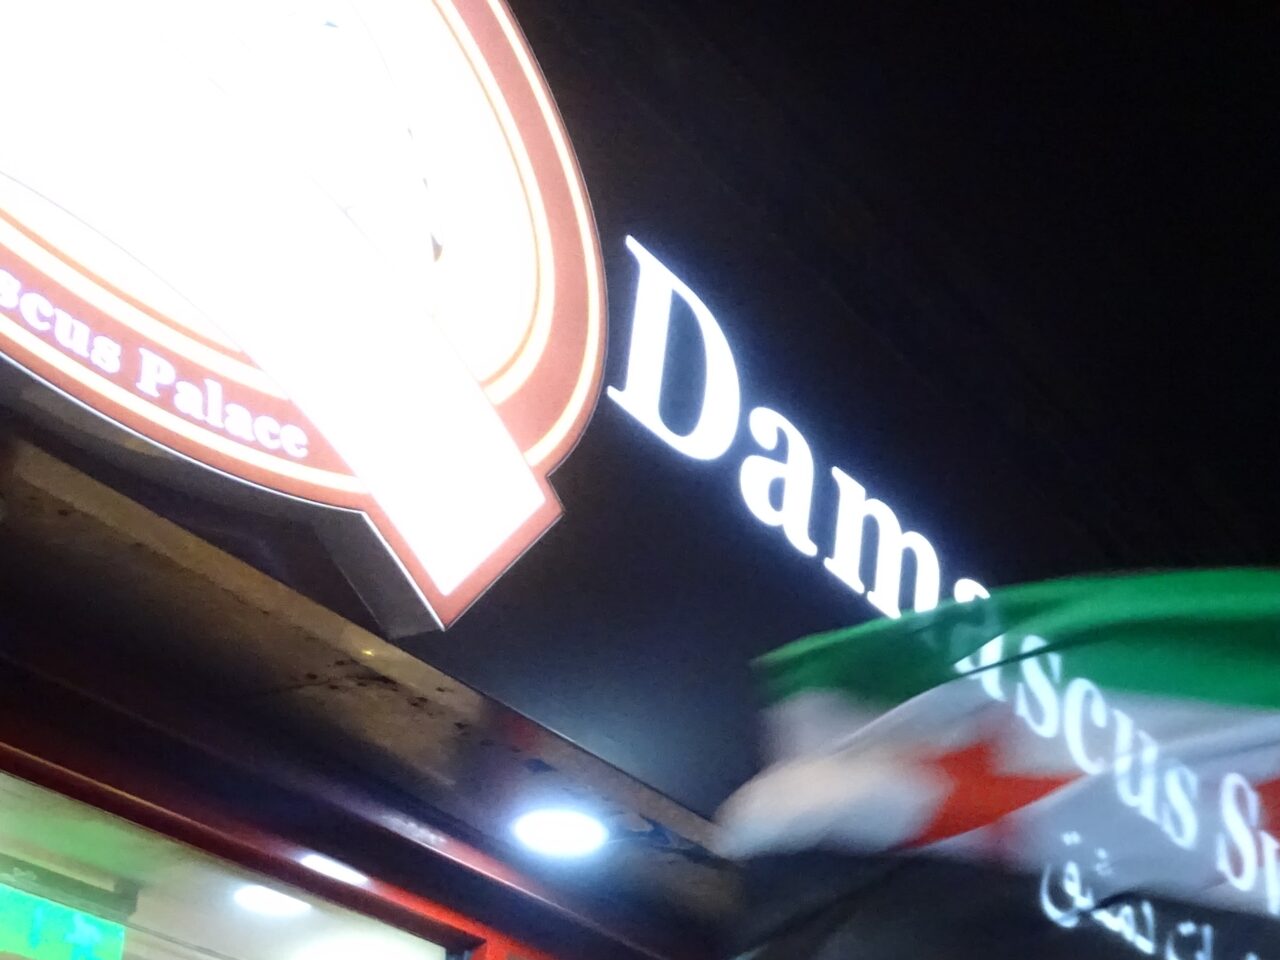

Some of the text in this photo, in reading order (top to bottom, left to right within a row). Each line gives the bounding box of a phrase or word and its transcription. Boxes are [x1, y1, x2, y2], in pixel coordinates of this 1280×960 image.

[136, 346, 310, 460] Palace
[607, 235, 1199, 849] Damascus
[1038, 831, 1157, 955] دمشق
